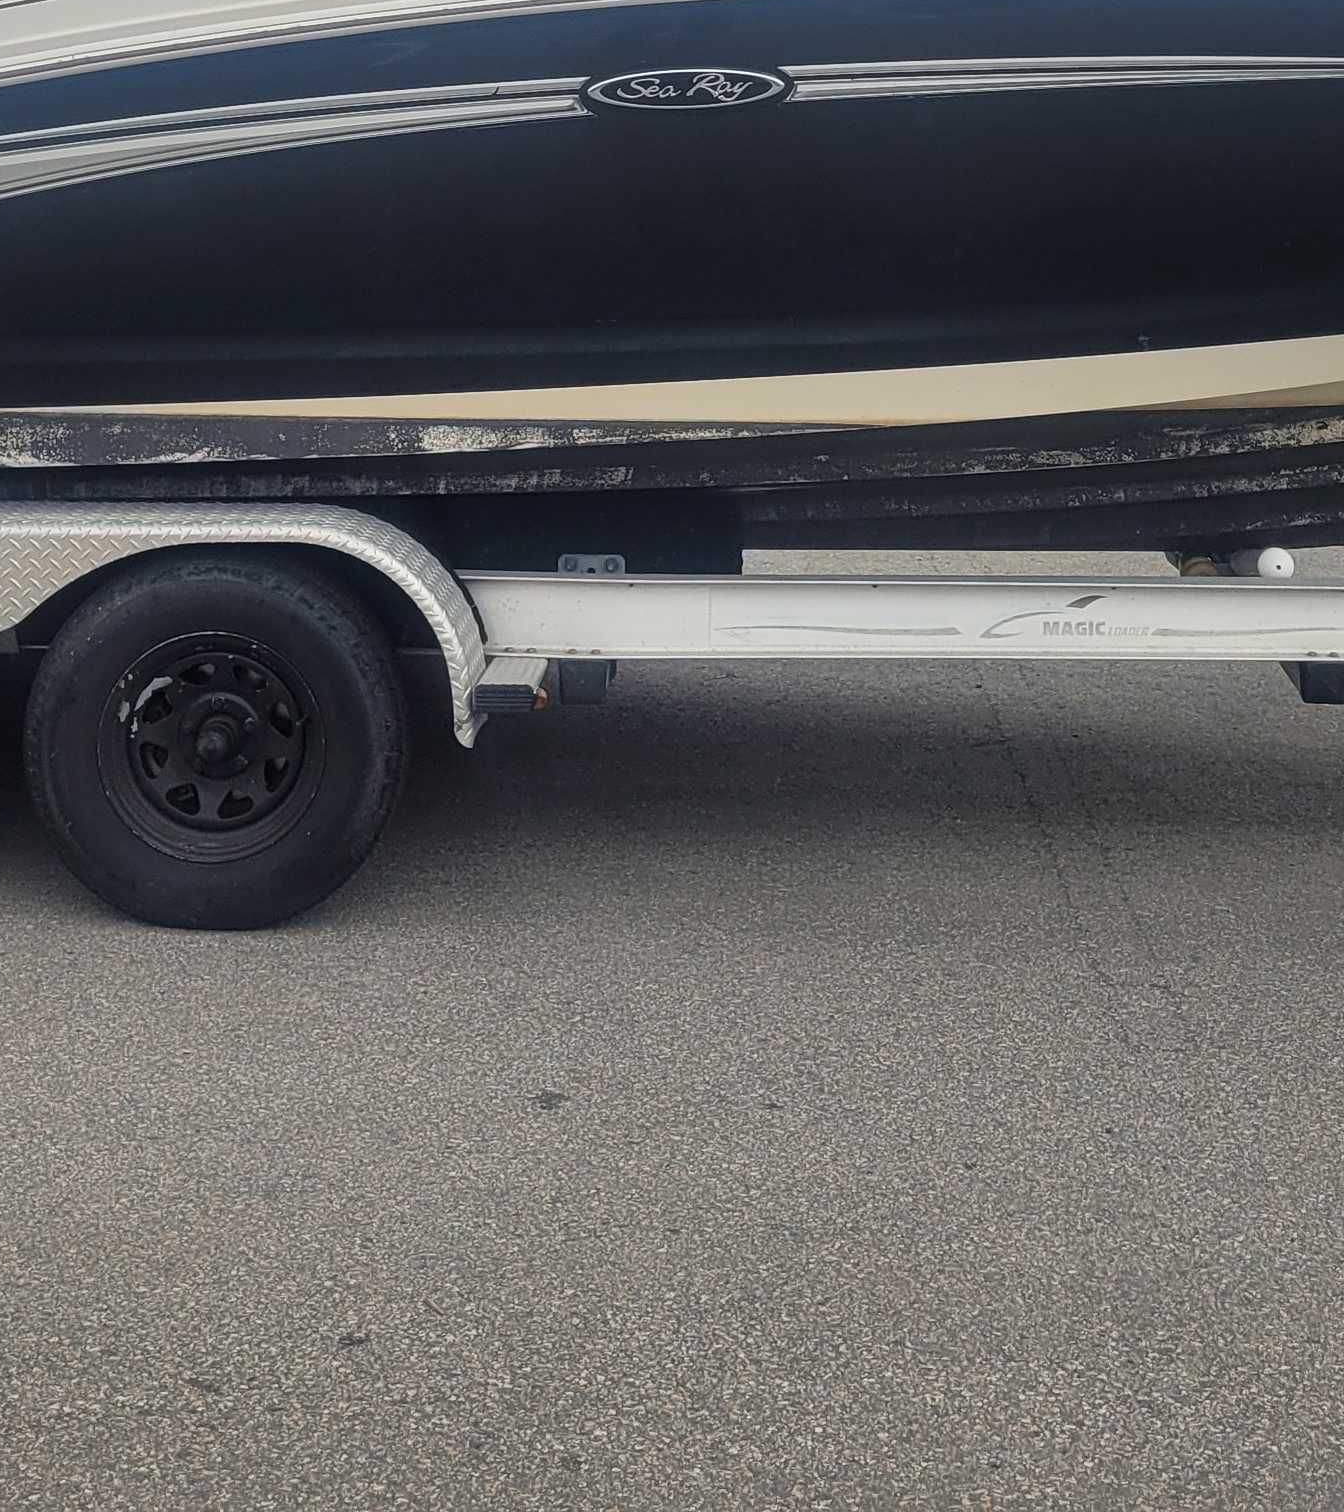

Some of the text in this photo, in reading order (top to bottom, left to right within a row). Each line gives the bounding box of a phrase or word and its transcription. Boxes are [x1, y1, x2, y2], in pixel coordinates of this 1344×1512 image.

[616, 72, 754, 102] Sea Ray
[1042, 621, 1106, 636] MAGIC
